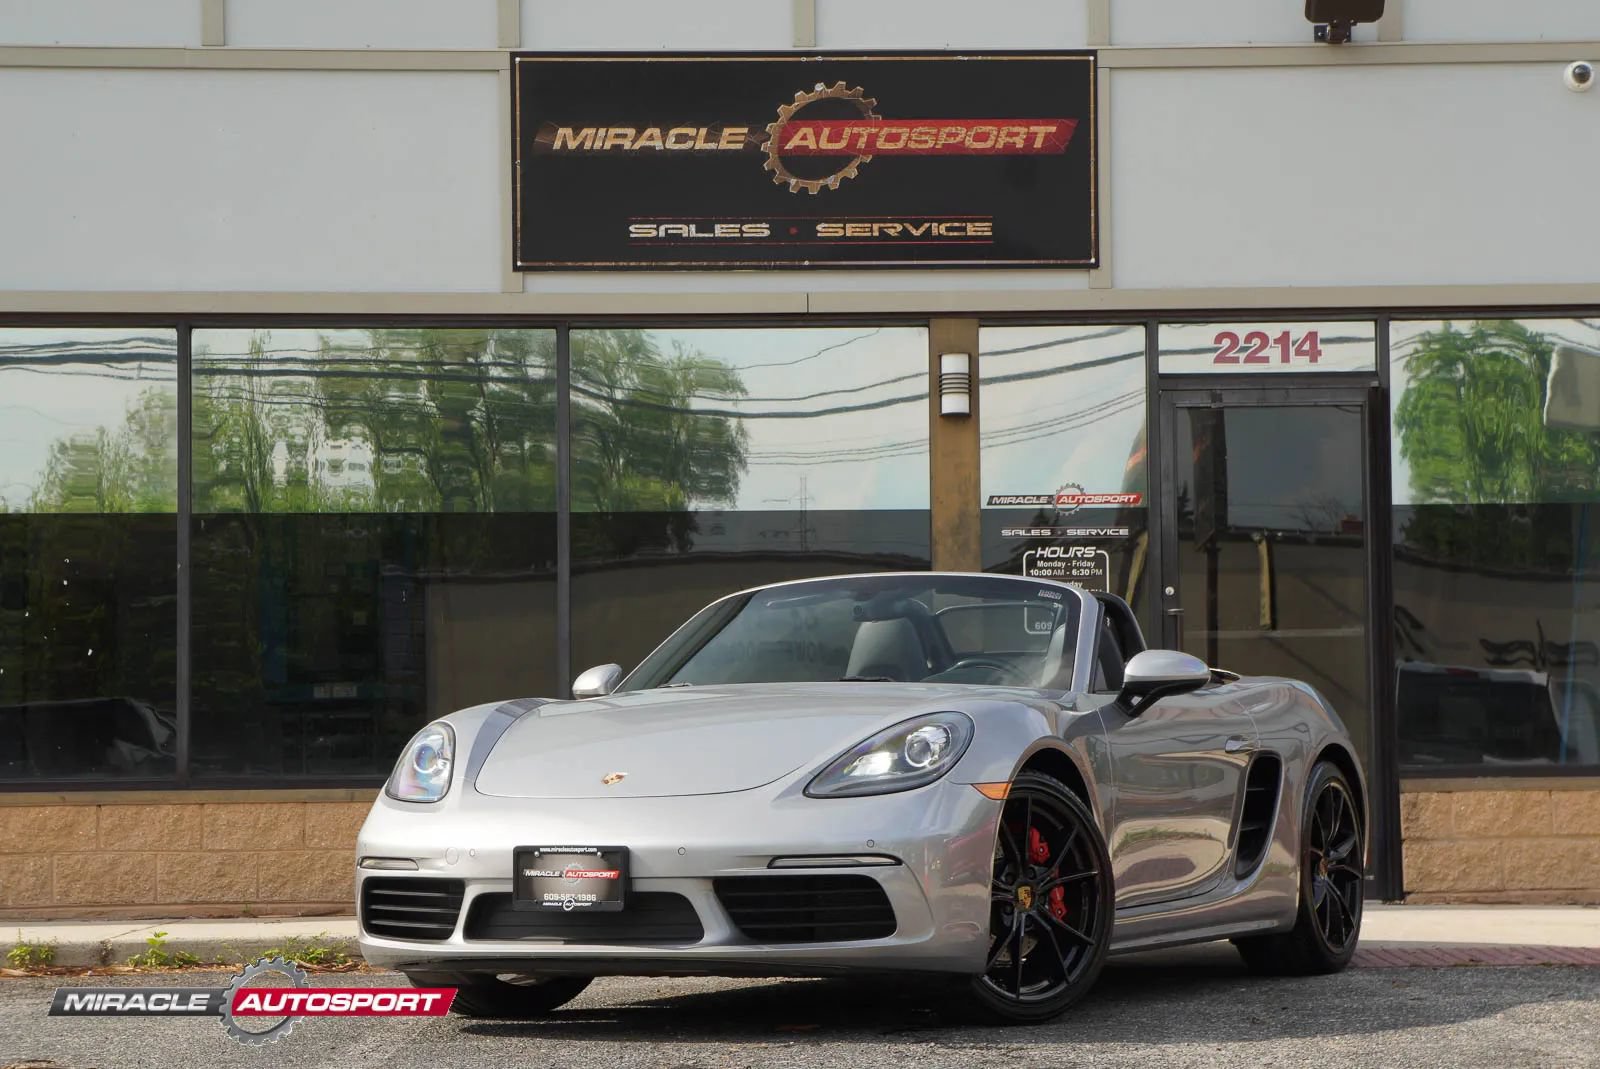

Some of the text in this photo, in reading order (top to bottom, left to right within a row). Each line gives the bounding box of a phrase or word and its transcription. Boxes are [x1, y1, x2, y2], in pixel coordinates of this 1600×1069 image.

[552, 124, 1058, 151] MIRACLE AUTOSPORT
[628, 222, 993, 238] SALES SERVICE
[1213, 331, 1322, 364] 2214
[992, 495, 1137, 505] MIRACLE AUTOSPORT
[1036, 547, 1096, 558] HOURS
[1037, 560, 1066, 568] Monday
